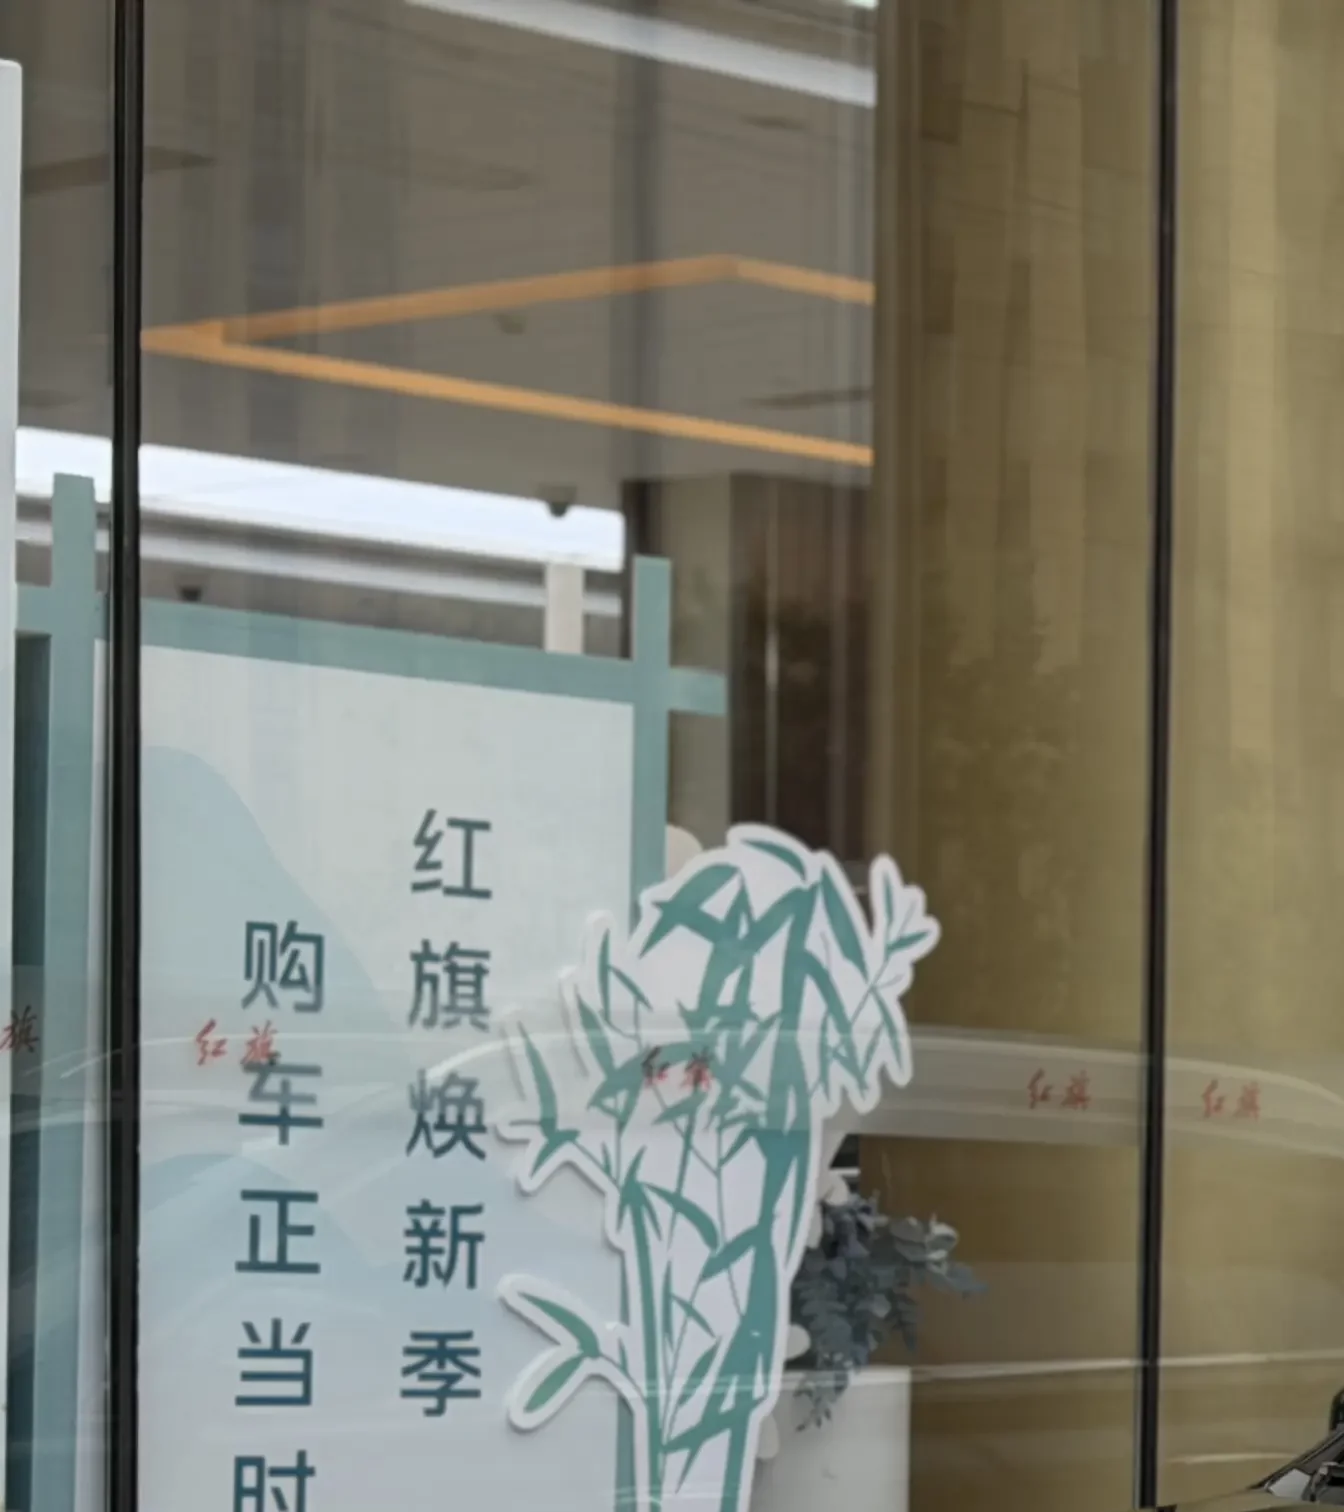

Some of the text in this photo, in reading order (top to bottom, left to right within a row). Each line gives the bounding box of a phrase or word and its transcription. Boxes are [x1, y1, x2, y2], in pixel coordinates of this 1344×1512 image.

[194, 1018, 281, 1067] 红旗
[400, 809, 494, 1418] 红旗焕新季
